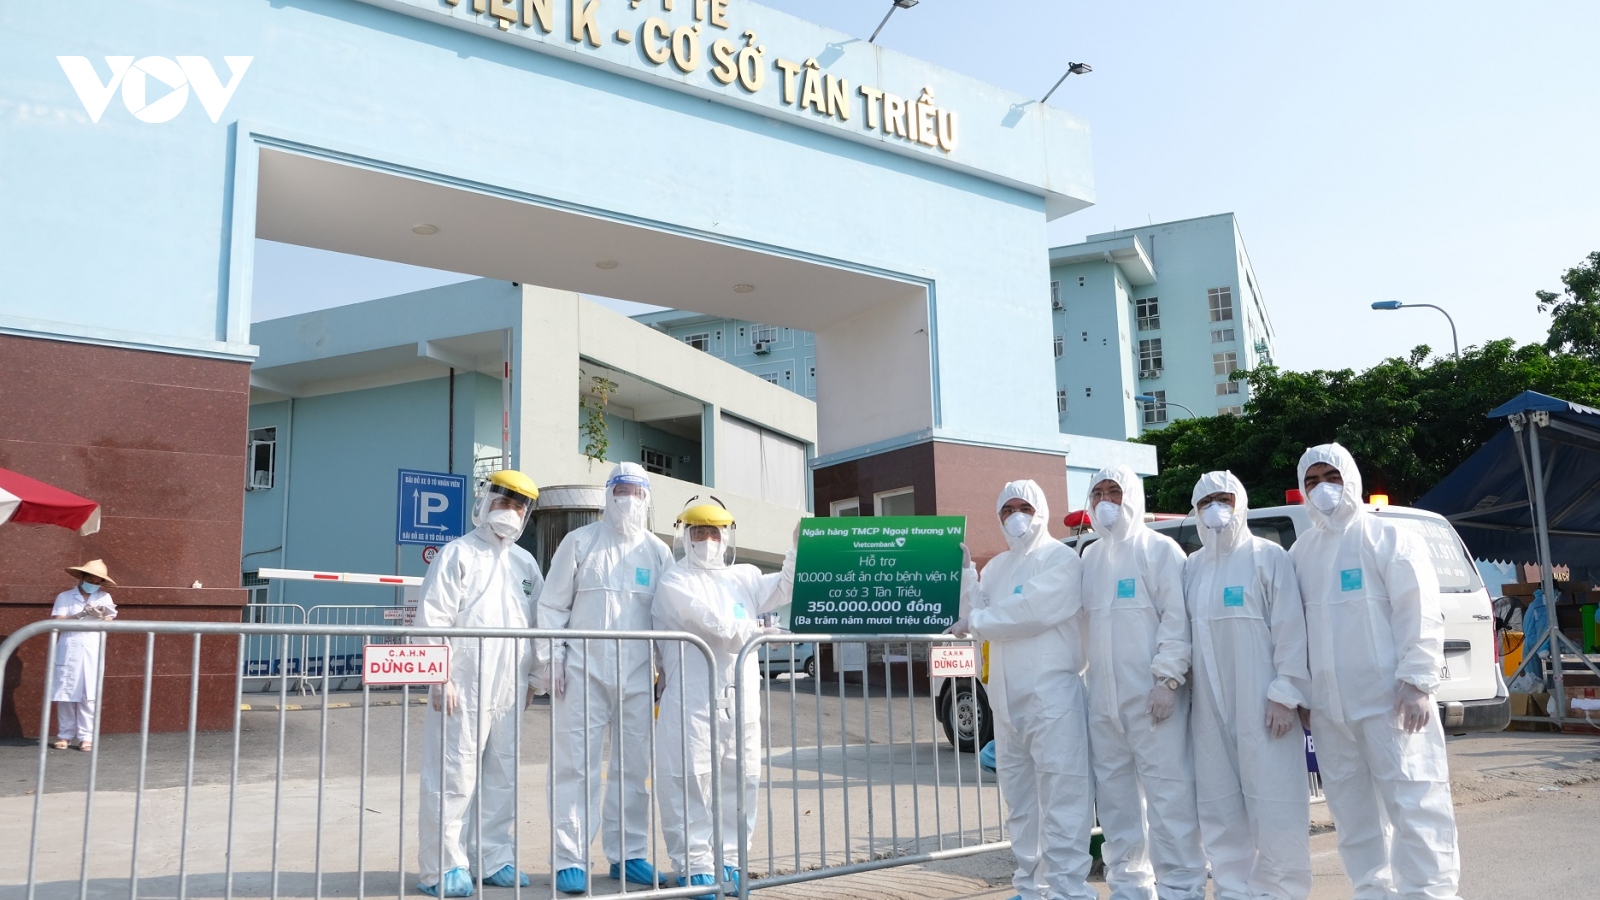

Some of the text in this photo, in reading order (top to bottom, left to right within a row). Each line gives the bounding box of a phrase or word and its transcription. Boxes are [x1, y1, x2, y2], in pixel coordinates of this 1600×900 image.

[571, 0, 602, 48] K
[641, 16, 702, 73] CƠ
[711, 29, 767, 93] SỞ
[775, 57, 849, 121] TÂN
[420, 491, 450, 524] P
[418, 533, 425, 541] XE
[802, 526, 962, 537] Ngân hàng TMCP Ngoại thương VN
[859, 554, 897, 567] Hỗ trợ
[797, 569, 959, 583] 10.000 suất ăn cho bệnh viện K
[828, 586, 922, 598] cơ sở 3 Tân Triều
[807, 600, 942, 614] 350.000.000 đồng
[794, 614, 954, 627] (Ba trăm năm mươi triệu đồng)
[388, 649, 426, 657] C.A.H.N
[370, 658, 443, 676] DỪNG LẠI
[934, 656, 973, 670] DỪNG LẠI
